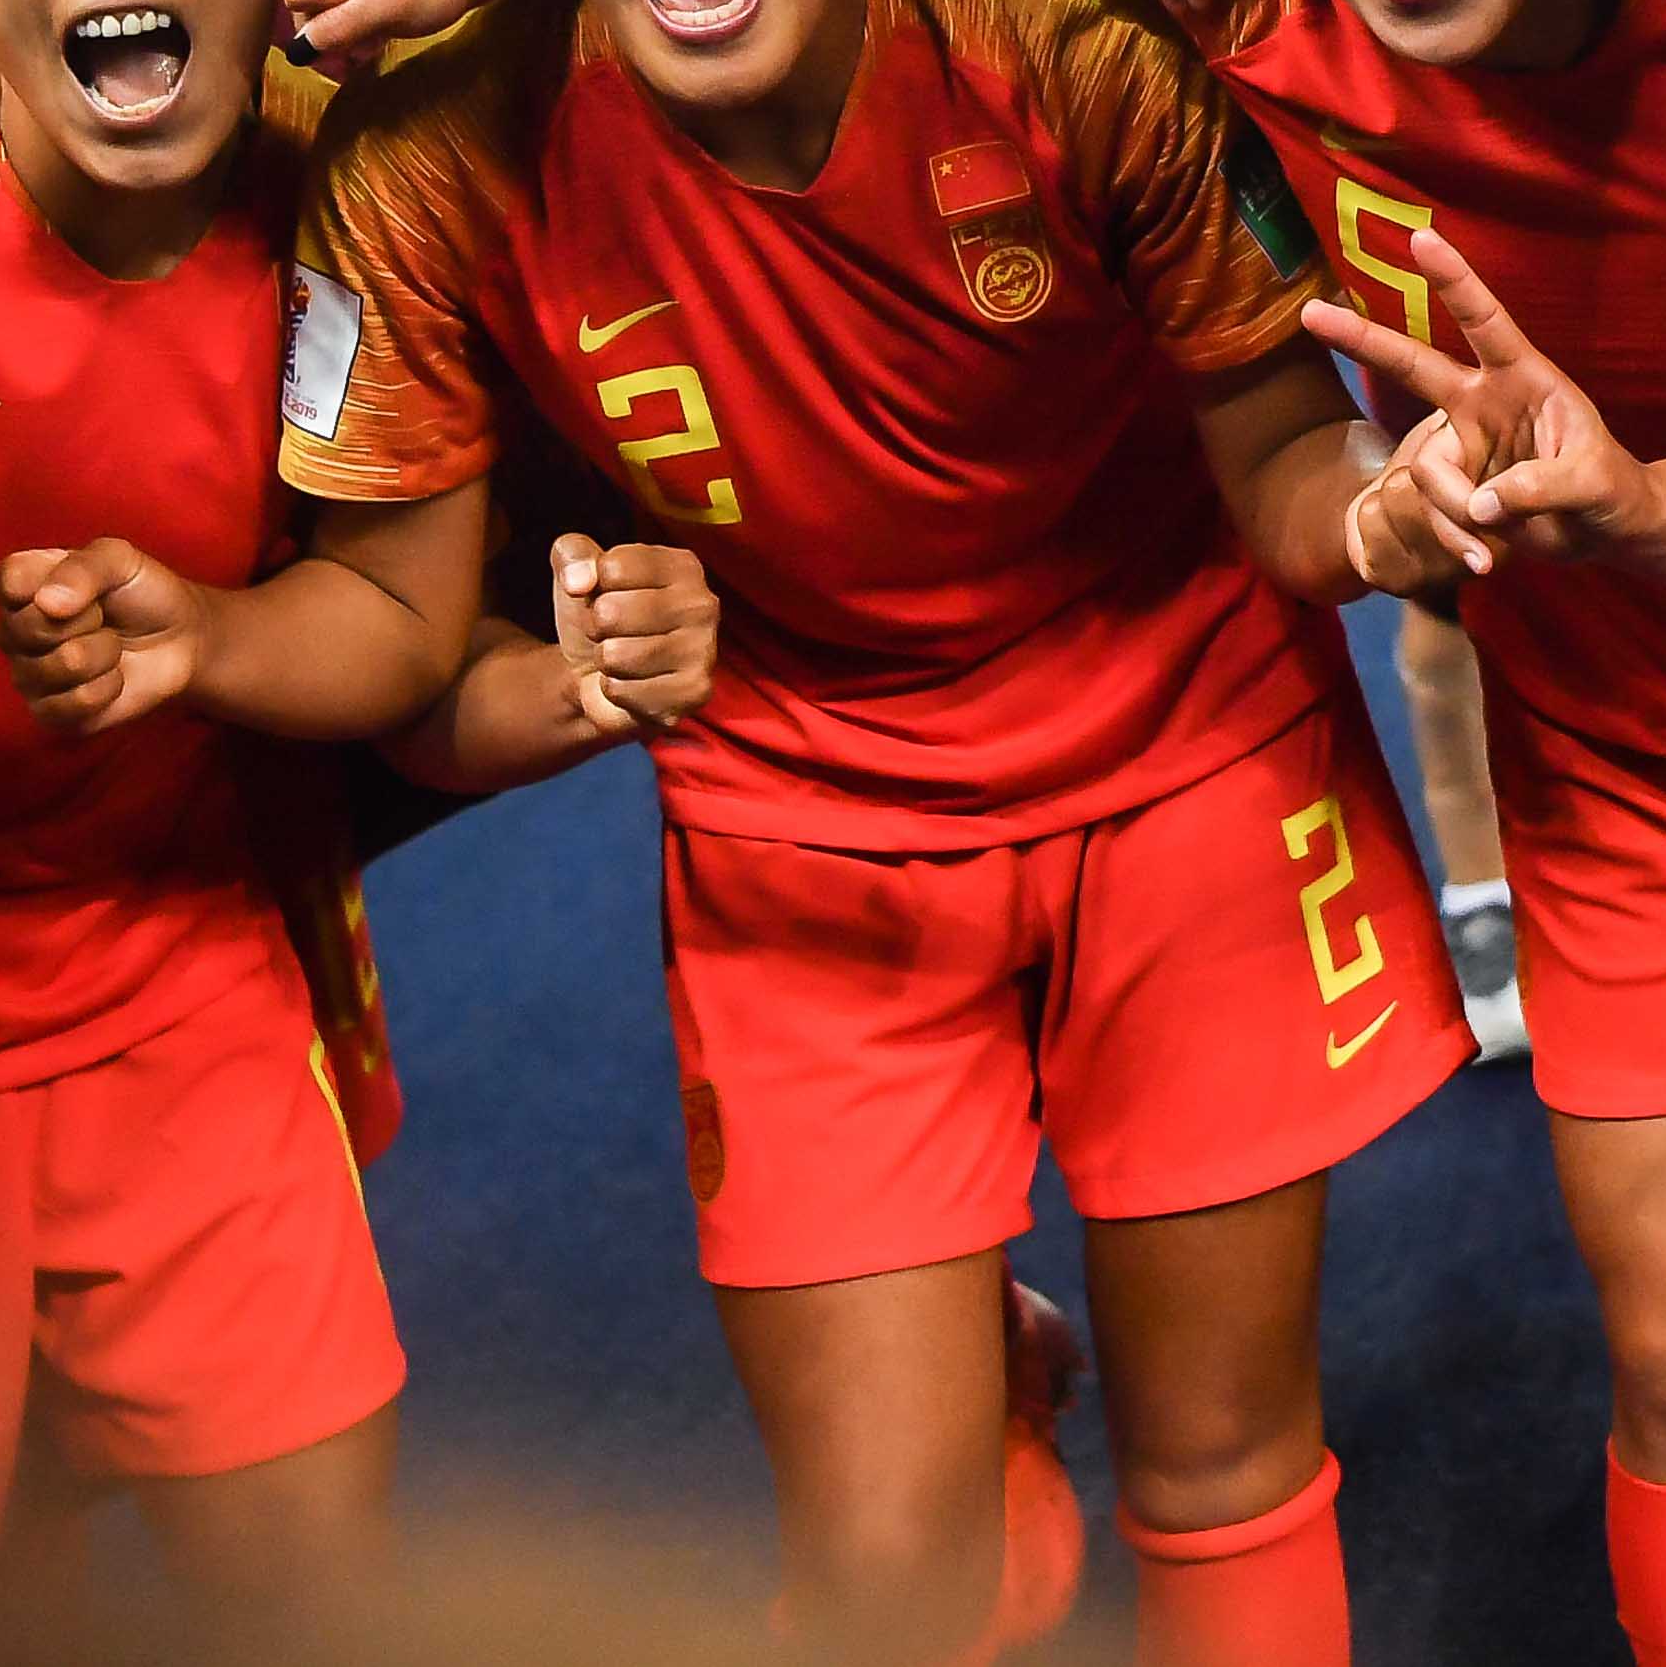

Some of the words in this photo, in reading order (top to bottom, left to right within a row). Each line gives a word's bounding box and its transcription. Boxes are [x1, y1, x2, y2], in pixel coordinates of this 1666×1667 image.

[1335, 176, 1433, 347] 5
[596, 364, 743, 525] 2
[1281, 796, 1384, 1006] 2
